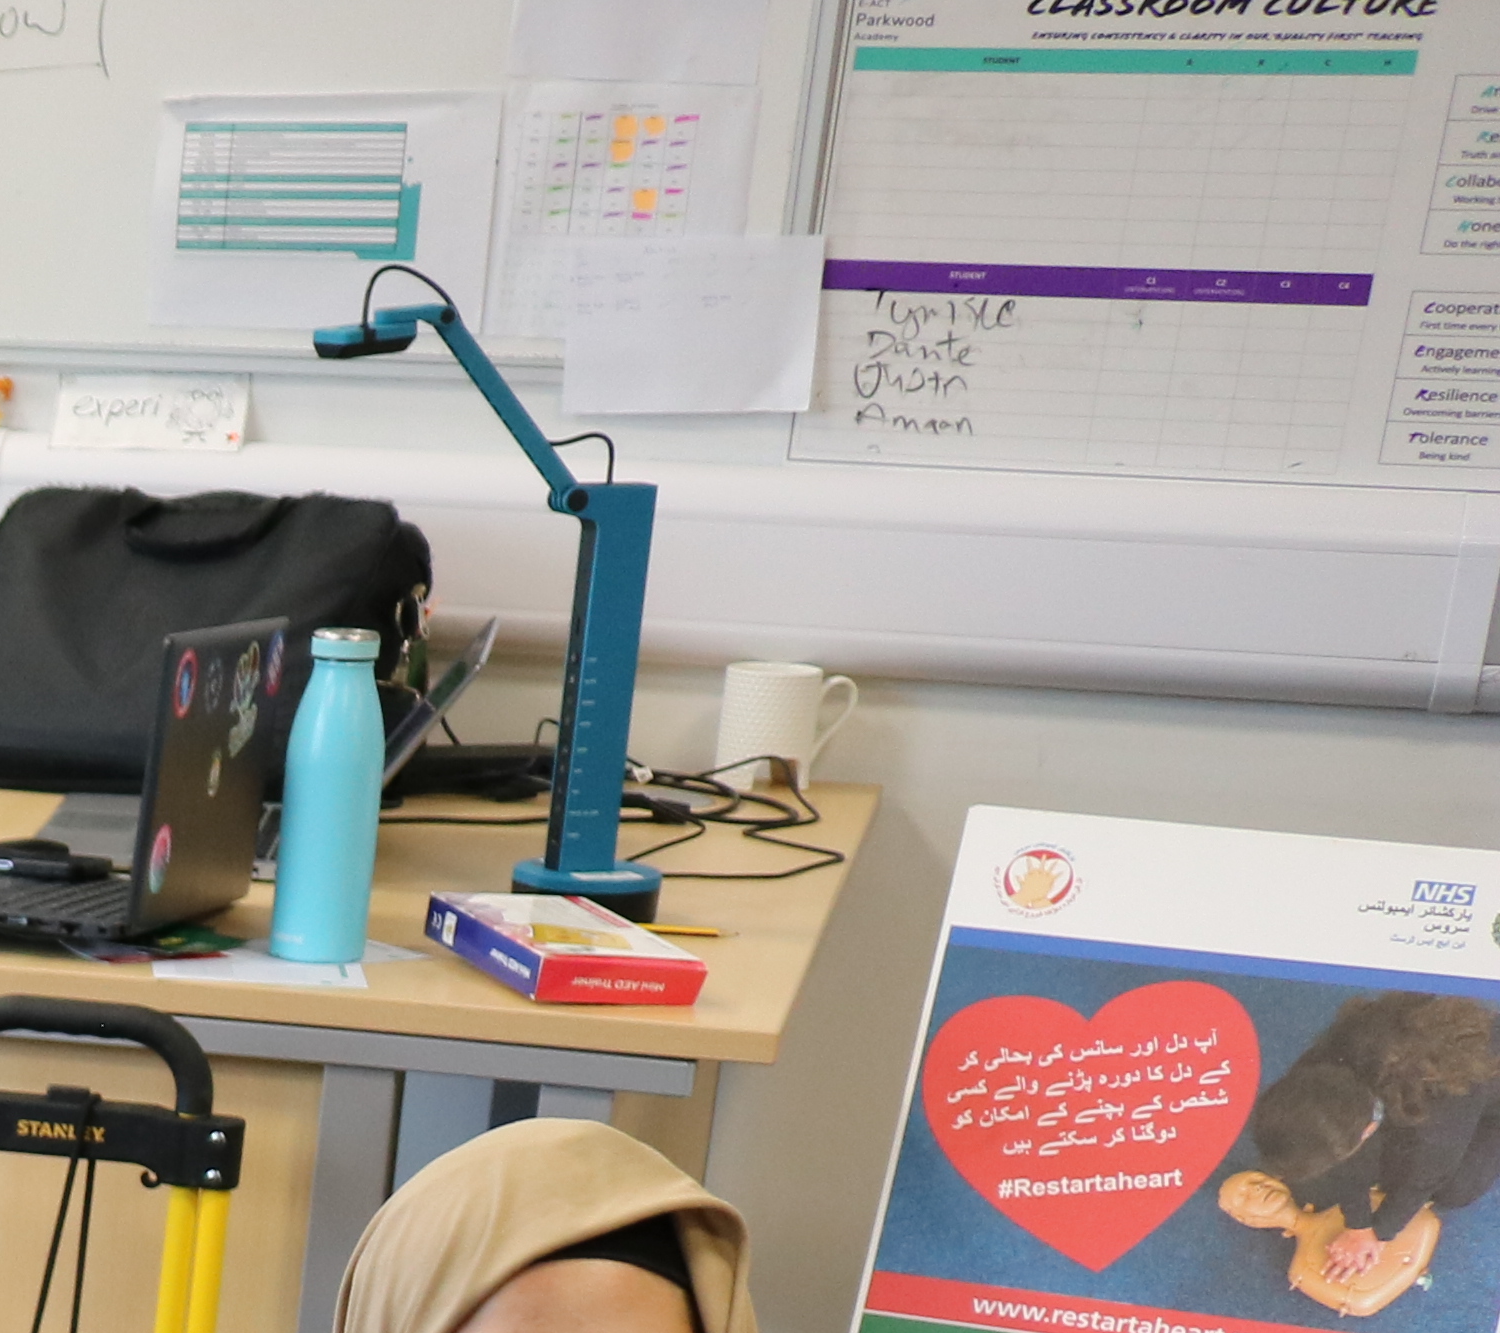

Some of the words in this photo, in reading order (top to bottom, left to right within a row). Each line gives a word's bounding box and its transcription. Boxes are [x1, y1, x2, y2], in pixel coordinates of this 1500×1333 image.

[855, 13, 936, 27] Parkwood
[854, 32, 900, 41] Academy
[1031, 32, 1087, 41] ENSURING
[1090, 32, 1167, 40] CONSISTENCY
[1179, 32, 1226, 41] CLARITY
[948, 271, 987, 280] STUDENT
[1414, 388, 1498, 402] Resilience
[1403, 407, 1463, 418] Overcoming
[1408, 428, 1489, 446] Tolerance
[1414, 882, 1474, 904] NHS
[571, 976, 611, 989] Trainer
[614, 978, 638, 991] AED
[641, 978, 665, 993] Mini
[1130, 1036, 1159, 1058] اور
[1165, 1032, 1188, 1053] دل
[1169, 1062, 1192, 1082] دل
[16, 1118, 106, 1143] STANLY
[998, 1167, 1183, 1199] #Restartaheart
